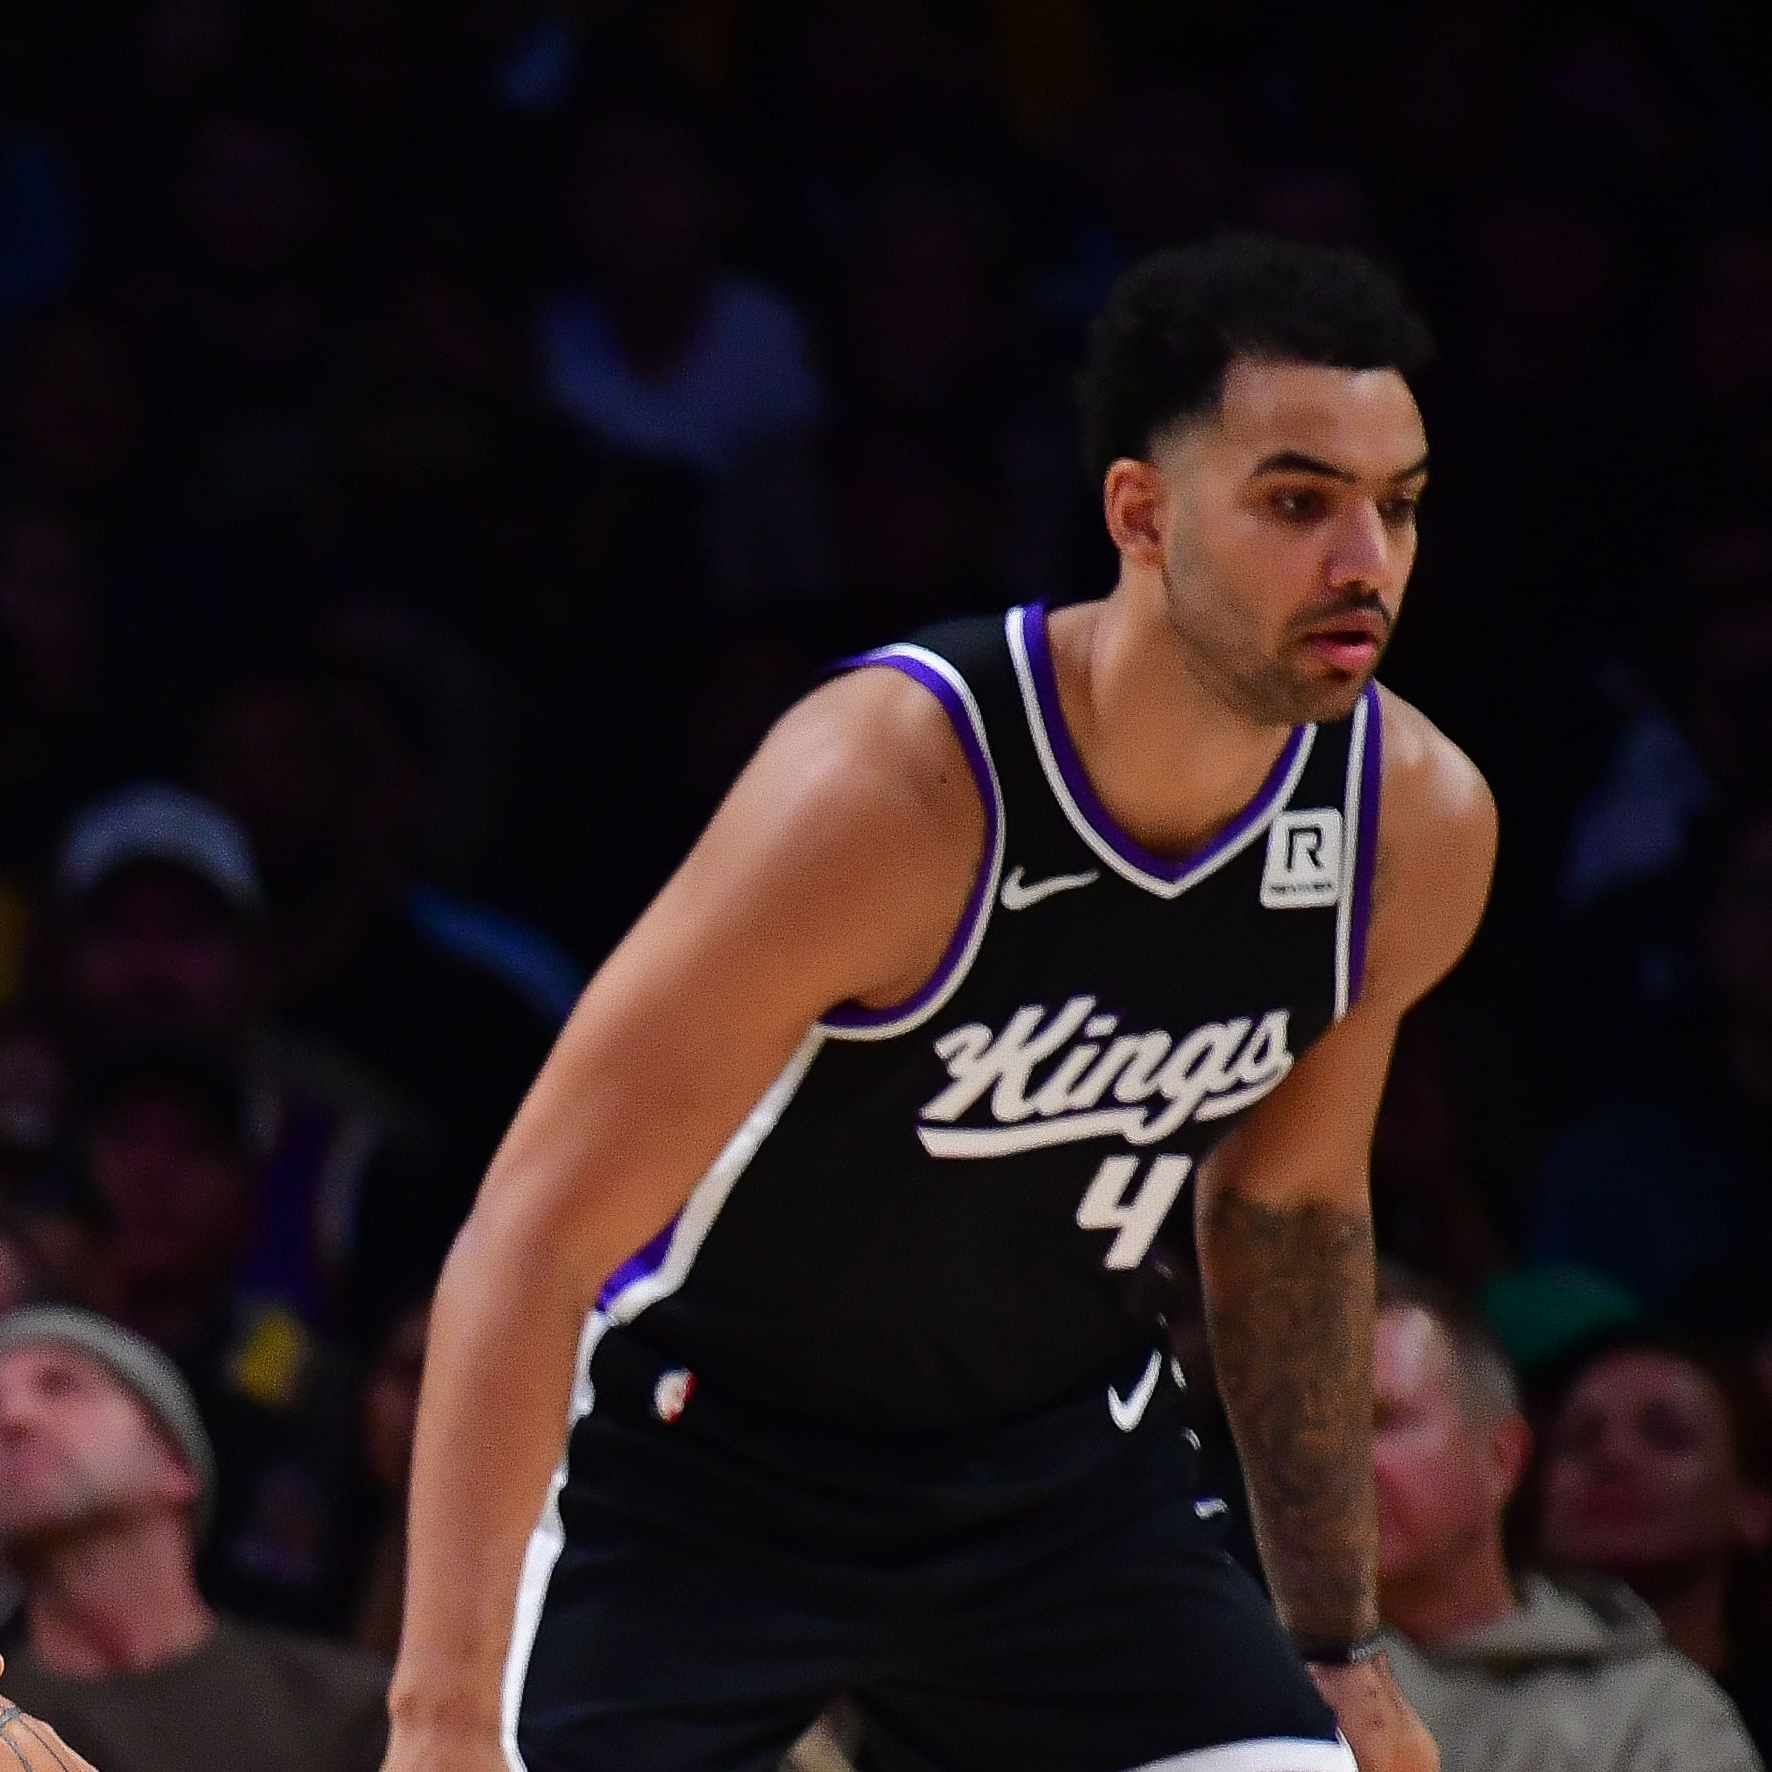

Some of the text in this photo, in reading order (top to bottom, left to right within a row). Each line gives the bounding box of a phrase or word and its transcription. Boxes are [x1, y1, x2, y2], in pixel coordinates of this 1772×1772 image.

[1286, 825, 1324, 872] R
[915, 994, 1296, 1160] Kings
[1074, 1152, 1194, 1271] 4
